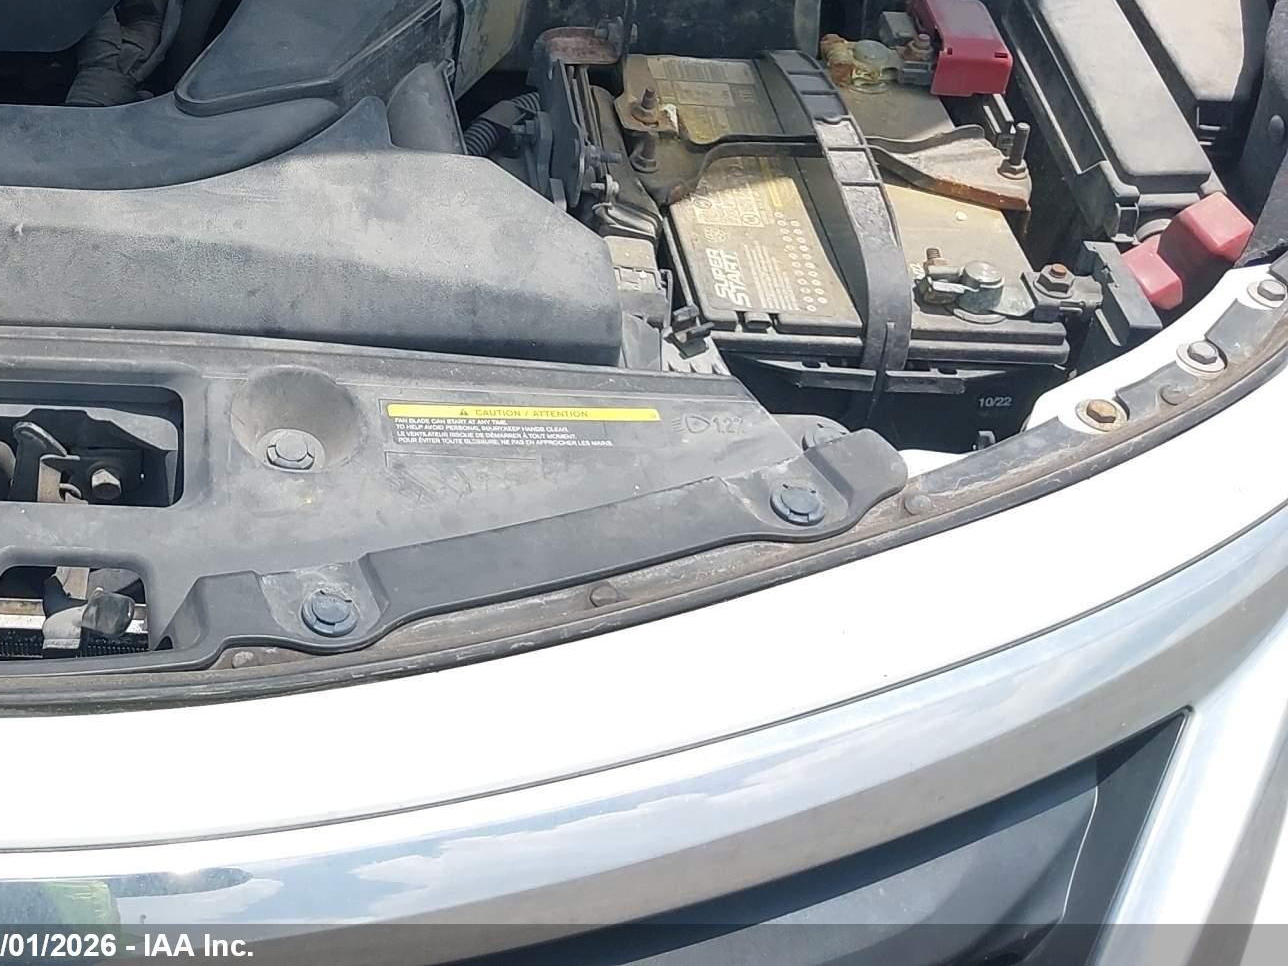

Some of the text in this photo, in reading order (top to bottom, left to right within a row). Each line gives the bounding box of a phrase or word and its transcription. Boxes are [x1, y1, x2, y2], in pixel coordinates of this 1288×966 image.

[706, 248, 729, 298] SUPER
[720, 250, 752, 307] START
[476, 409, 521, 417] CAUTION
[533, 410, 588, 418] ATTENTION
[978, 396, 1012, 407] 10/22
